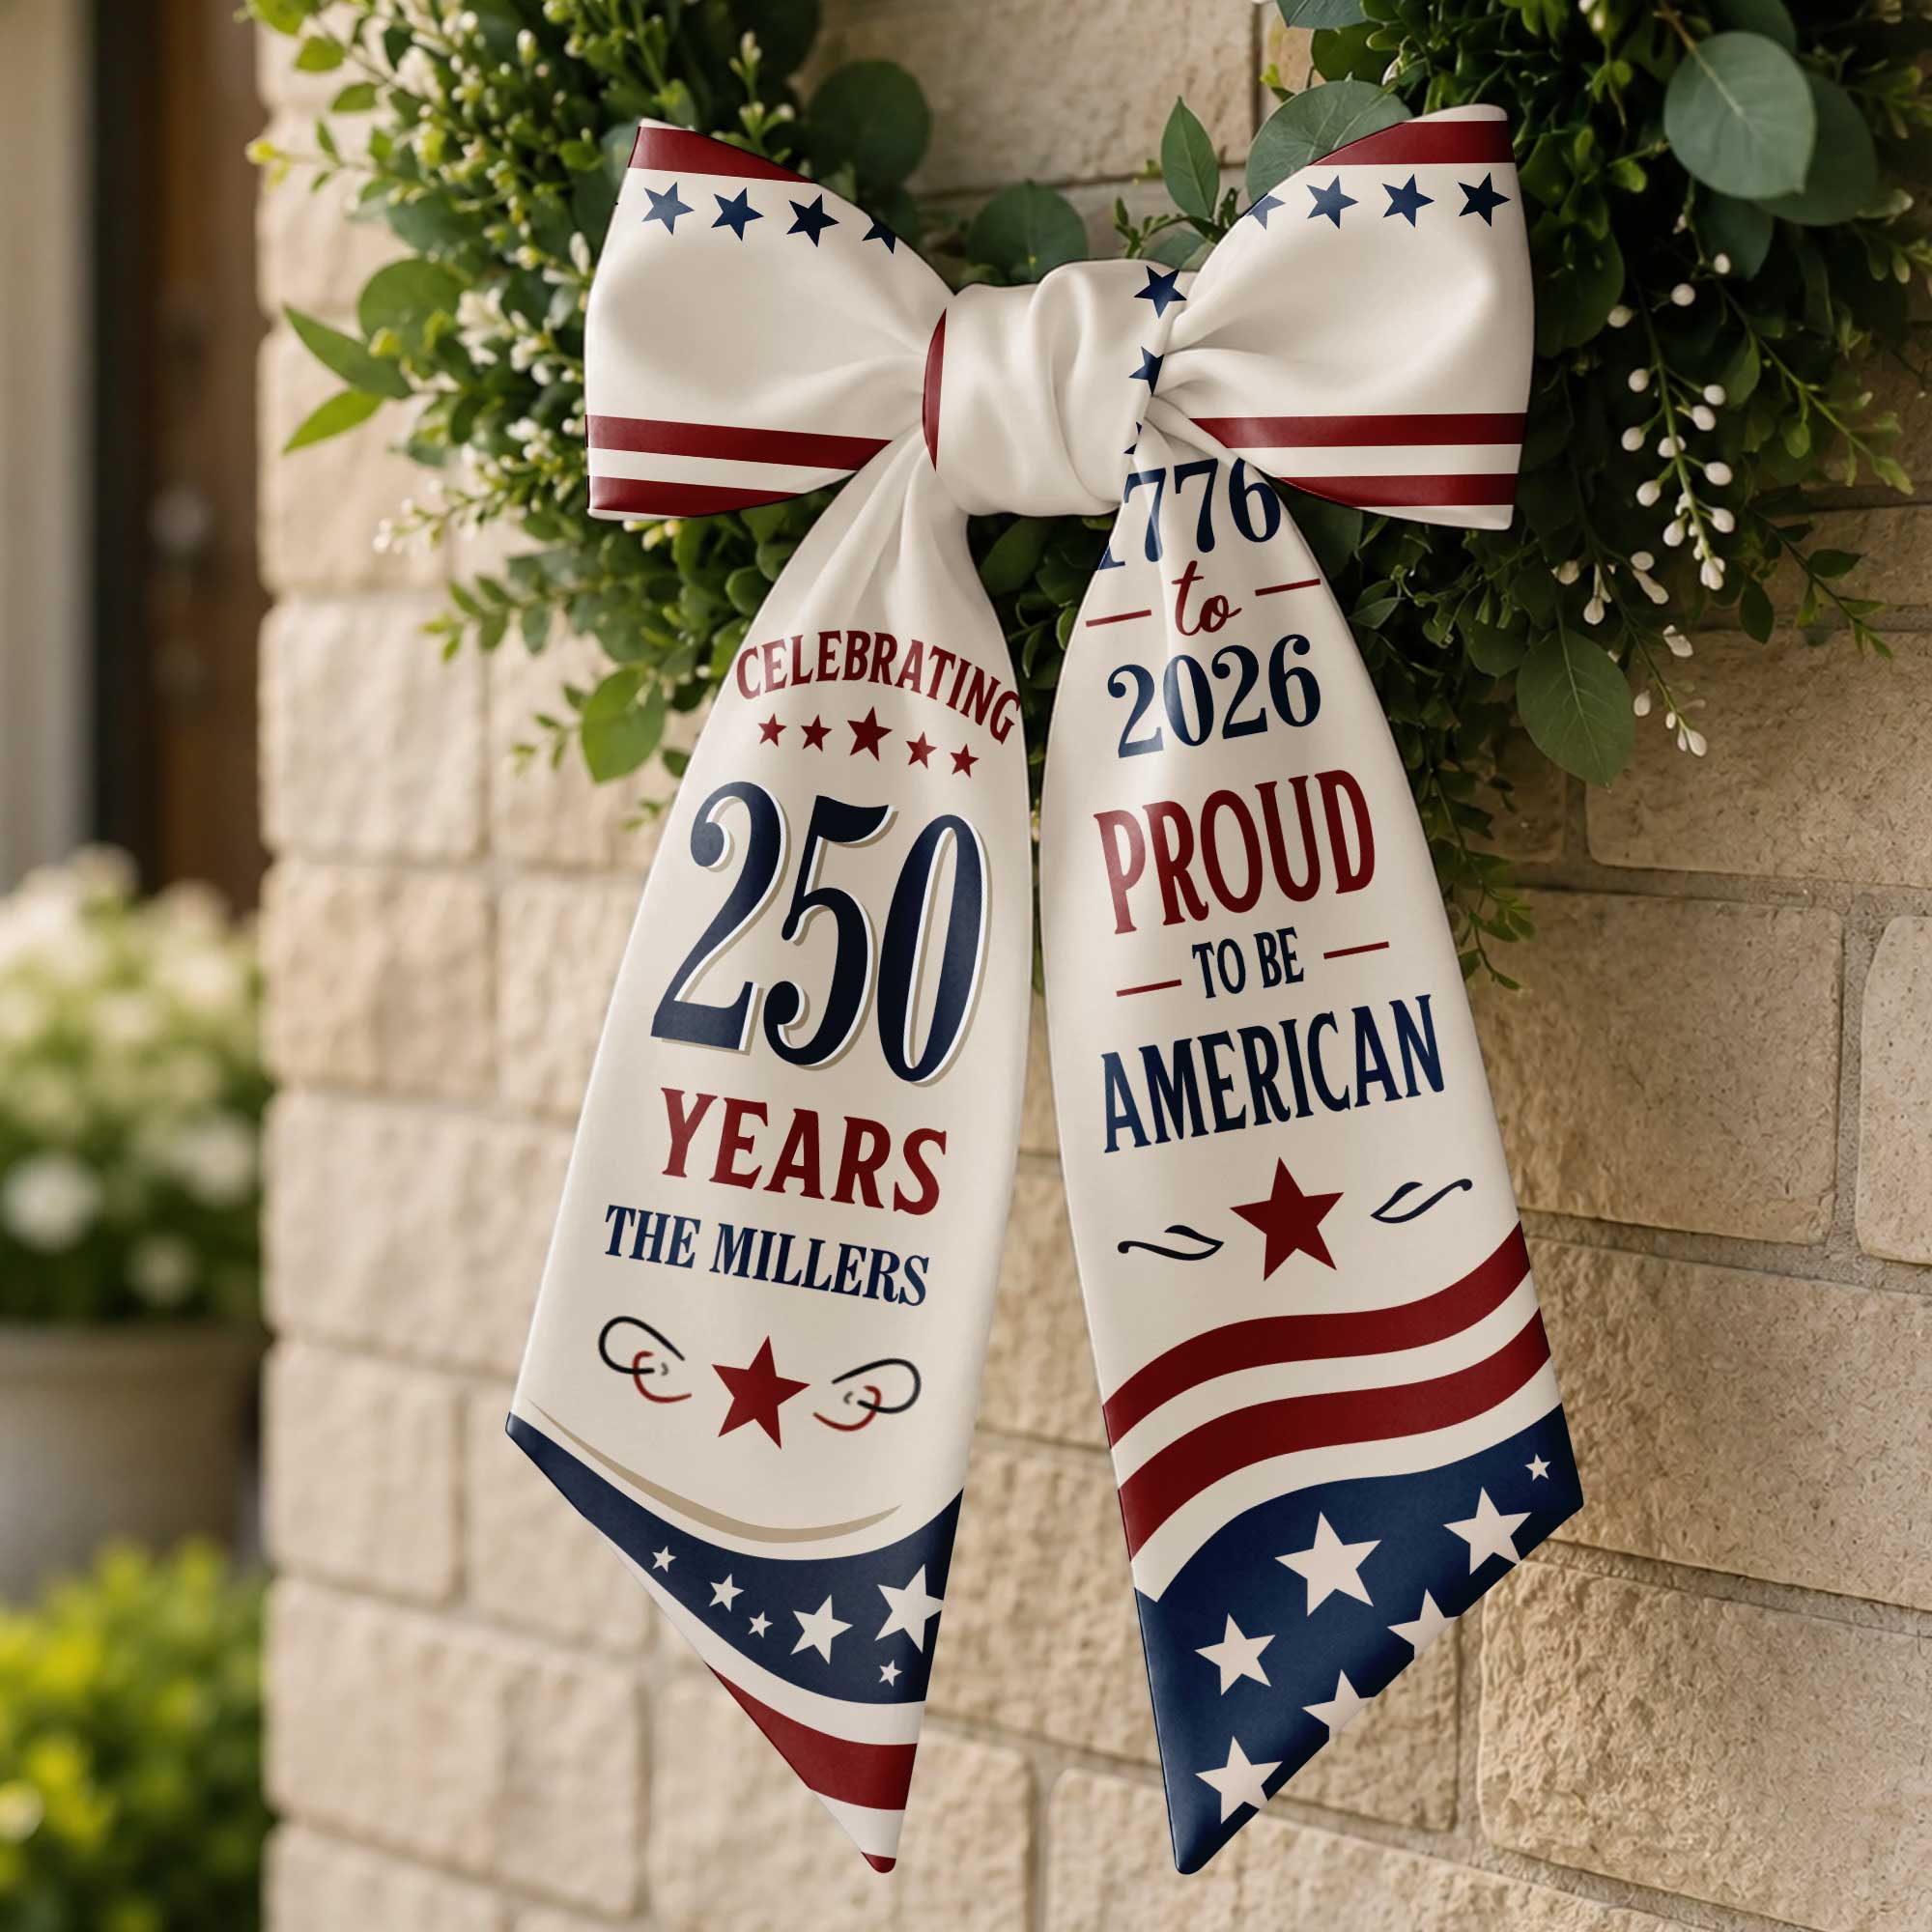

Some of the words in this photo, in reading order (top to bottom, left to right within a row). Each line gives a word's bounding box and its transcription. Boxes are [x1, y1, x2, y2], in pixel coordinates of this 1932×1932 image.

[1094, 457, 1281, 570] 776
[1172, 560, 1242, 636] to
[736, 630, 1020, 745] CELEBRATING
[1107, 634, 1321, 758] 2026
[1093, 769, 1375, 934] PROUD
[650, 781, 991, 1086] 250
[1191, 938, 1246, 999] TO
[1253, 926, 1304, 988] BE
[1100, 994, 1445, 1153] AMERICAN
[660, 1087, 947, 1215] YEARS
[605, 1205, 701, 1269] THE
[709, 1223, 929, 1307] MILLERS
